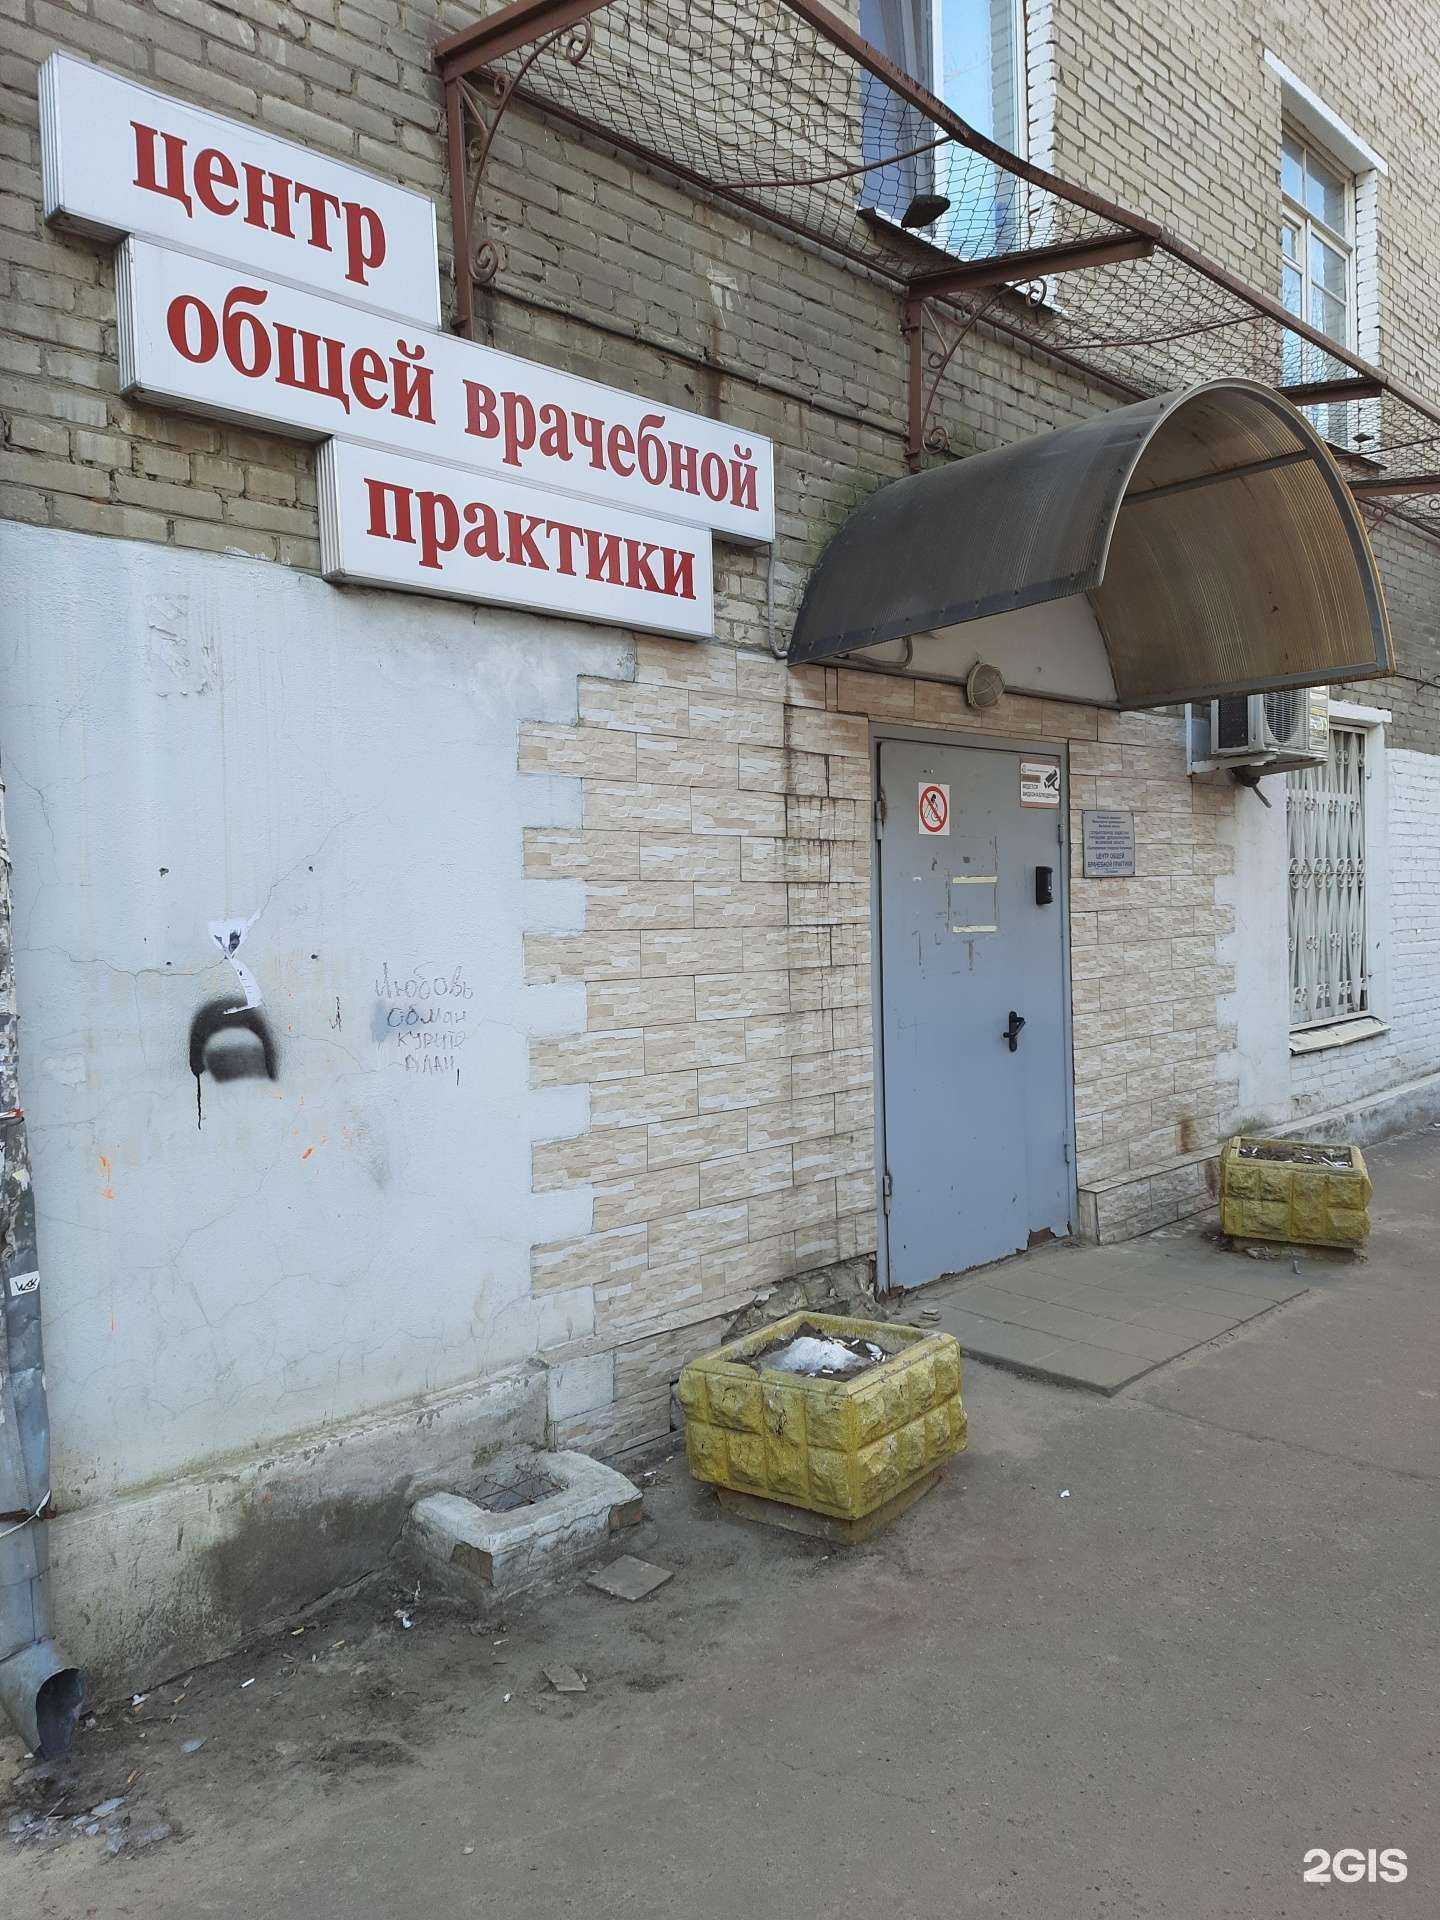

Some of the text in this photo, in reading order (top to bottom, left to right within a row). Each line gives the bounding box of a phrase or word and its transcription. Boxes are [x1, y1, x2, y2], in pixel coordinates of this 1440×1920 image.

[129, 120, 389, 287] центр
[166, 285, 761, 513] общей врачебной
[364, 476, 698, 601] практики
